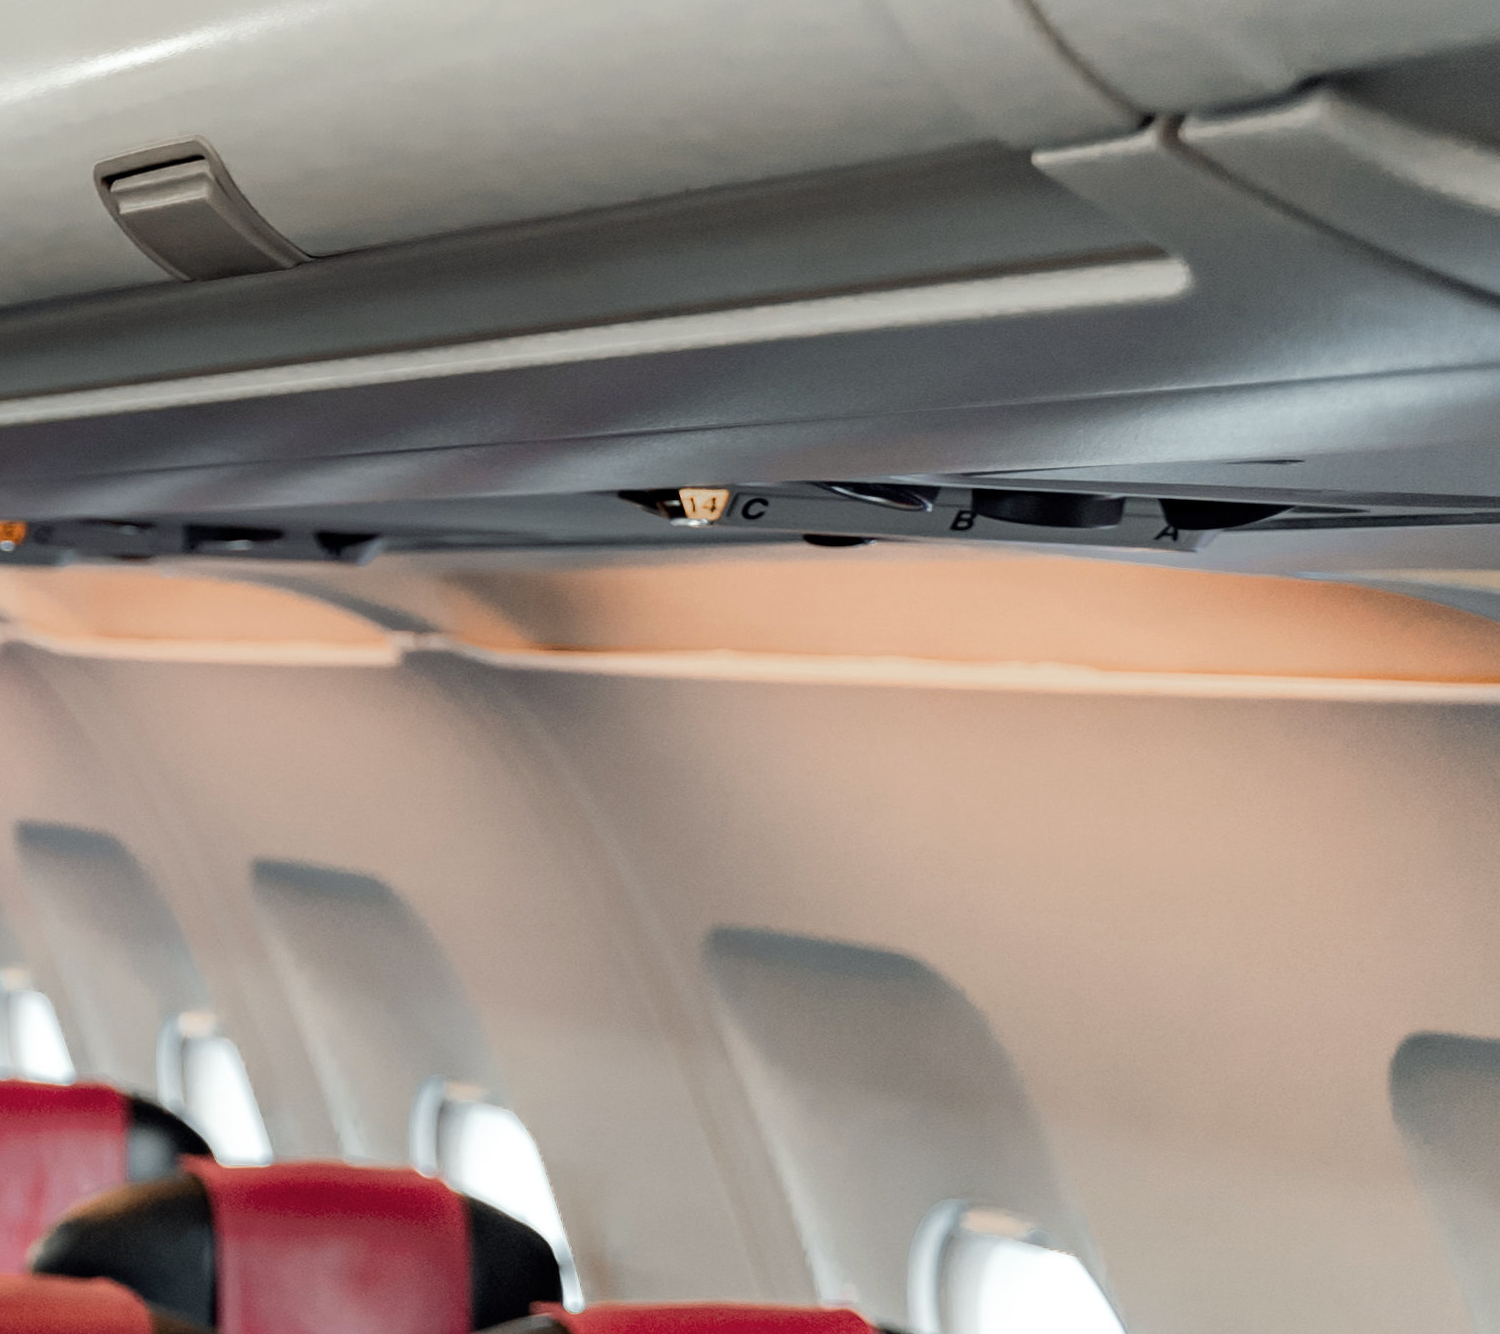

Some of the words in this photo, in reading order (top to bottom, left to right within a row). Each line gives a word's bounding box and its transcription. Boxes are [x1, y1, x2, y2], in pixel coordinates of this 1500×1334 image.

[686, 496, 717, 513] 14
[741, 497, 769, 520] C
[950, 510, 976, 531] B
[1154, 524, 1179, 542] A
